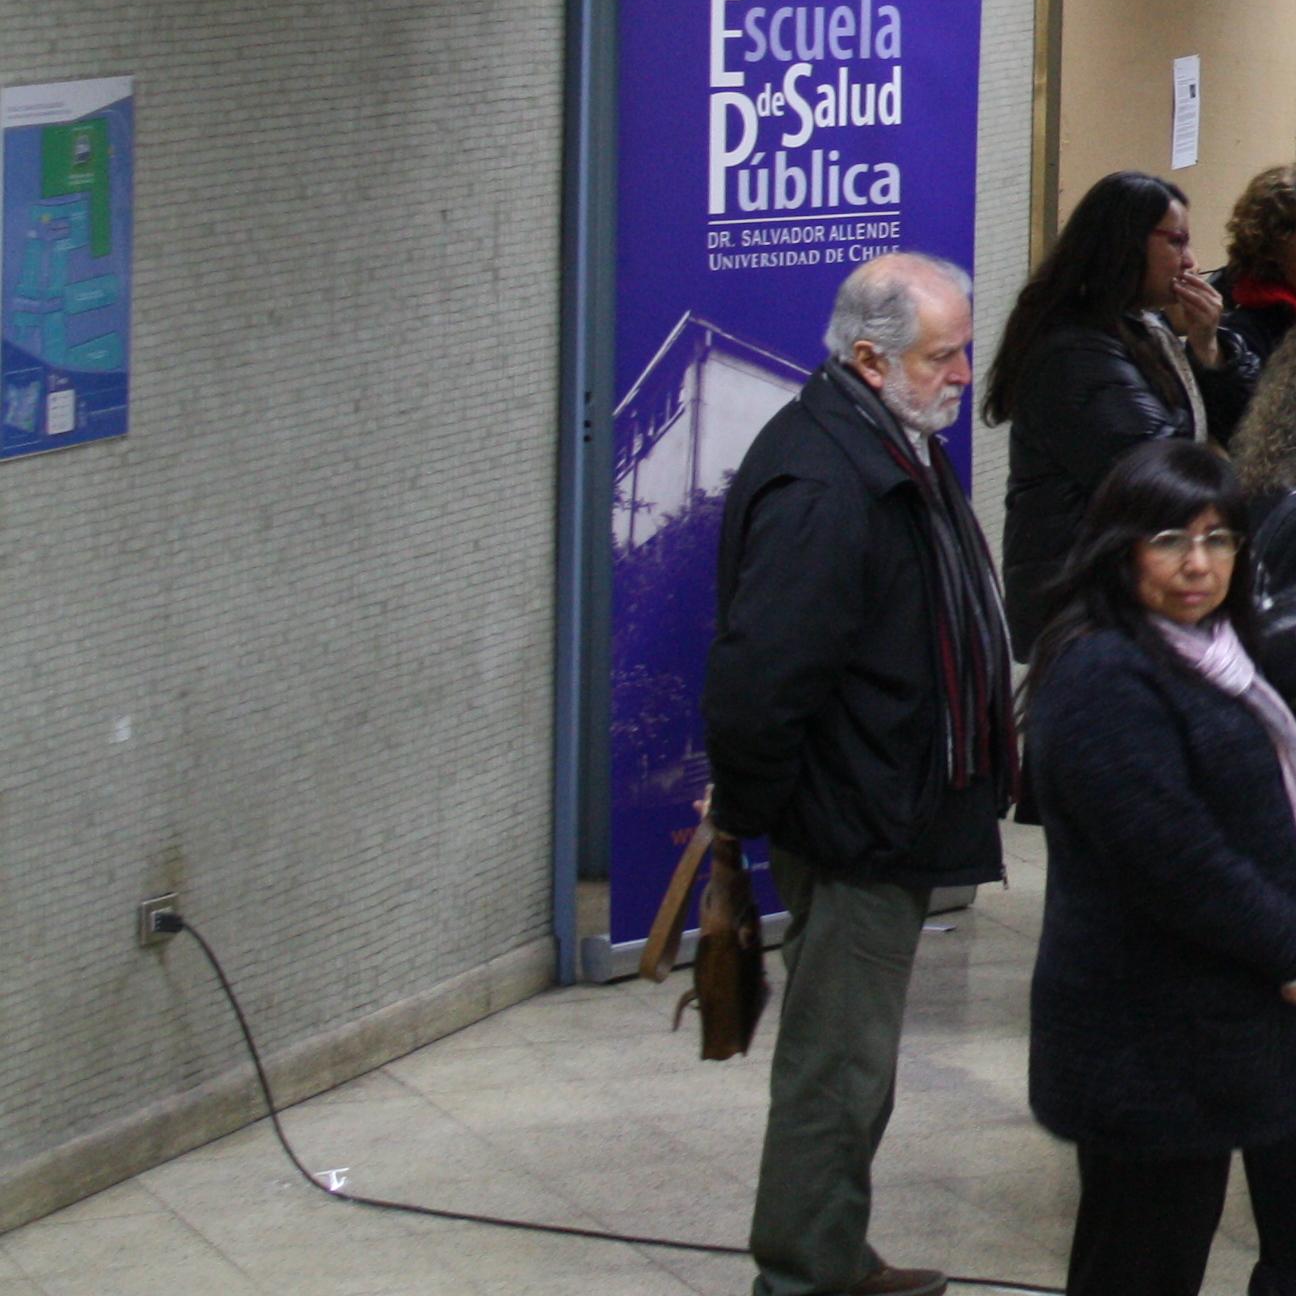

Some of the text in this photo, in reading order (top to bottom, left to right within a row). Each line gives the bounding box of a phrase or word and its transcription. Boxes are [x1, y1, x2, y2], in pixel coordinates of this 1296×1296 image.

[756, 62, 902, 148] de Salud
[708, 91, 901, 215] Pública
[707, 221, 901, 250] DR. SALVADOR ALLENDE
[709, 250, 820, 271] UNIVERSIDAD
[825, 248, 845, 264] DE
